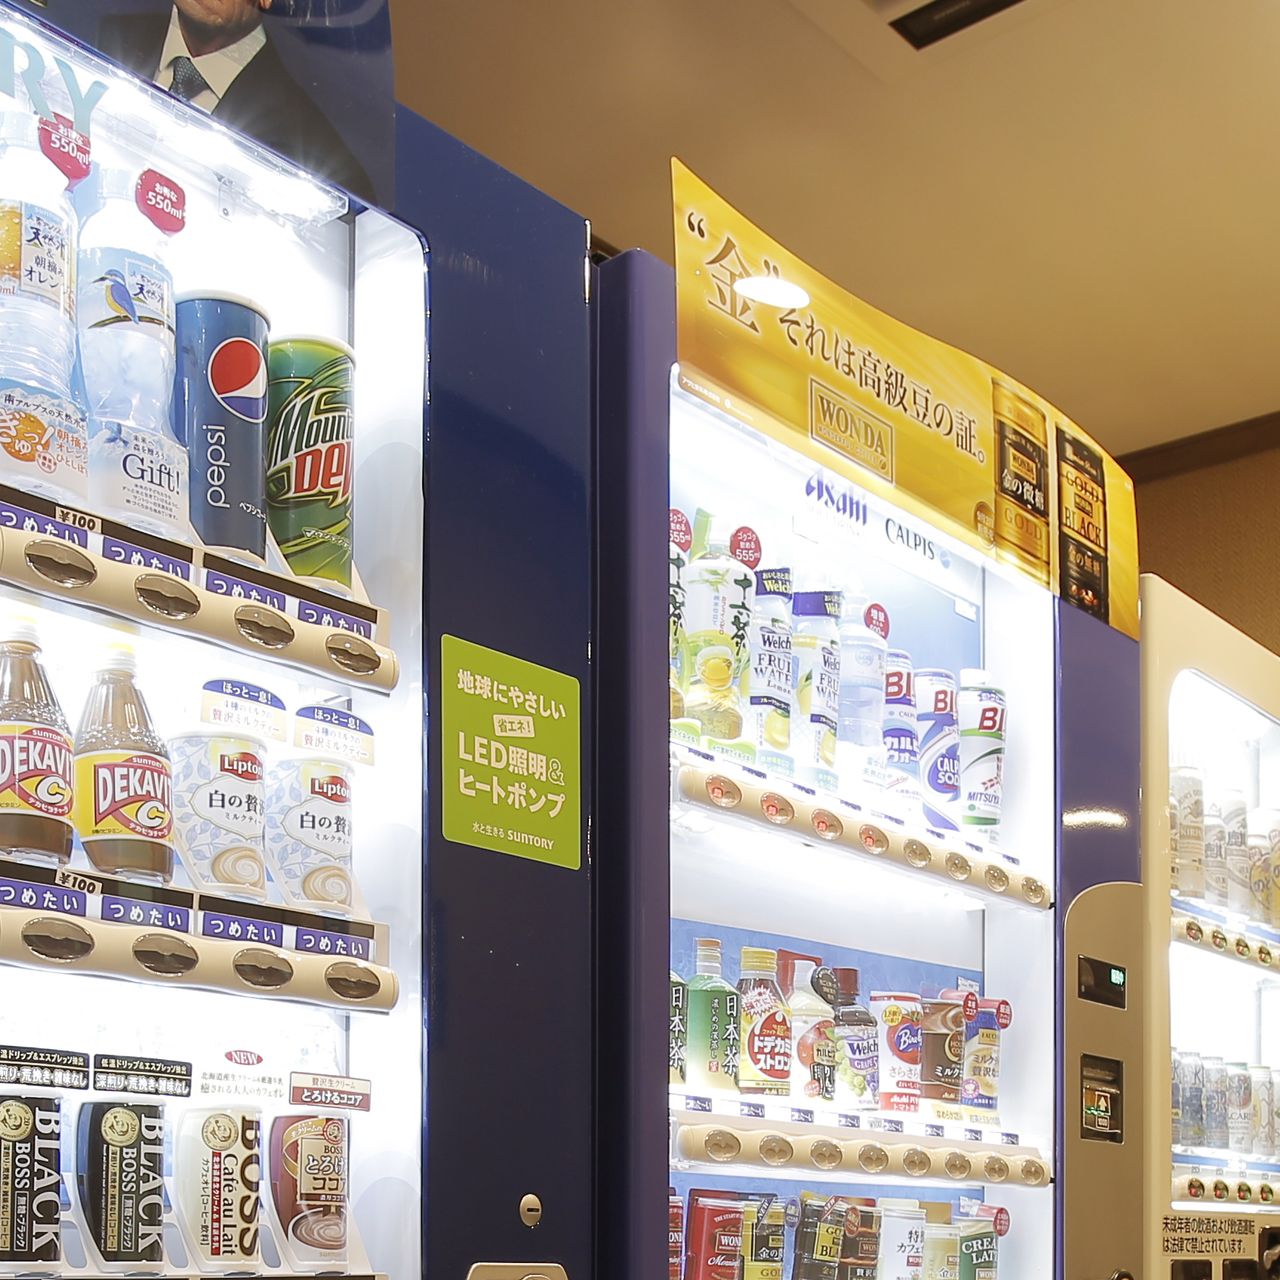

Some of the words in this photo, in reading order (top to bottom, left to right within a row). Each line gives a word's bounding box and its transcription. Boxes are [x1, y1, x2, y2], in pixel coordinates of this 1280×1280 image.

[779, 309, 985, 465] それは高級豆の証。
[818, 394, 887, 457] WONDA
[123, 454, 180, 494] Gift!
[203, 425, 230, 508] pepsi
[1065, 470, 1099, 502] GOLD
[805, 468, 867, 526] Asahi
[1002, 469, 1044, 510] 金の微糖
[885, 517, 935, 561] CALPIS
[1005, 507, 1041, 540] GOLD
[1064, 506, 1101, 547] BLACK
[457, 668, 566, 720] 地球にやさしい
[458, 731, 565, 786] LED照明&
[36, 776, 66, 803] C
[459, 768, 565, 818] ヒートポンプ
[137, 800, 167, 828] C
[473, 821, 504, 838] 水と生きる
[508, 830, 554, 850] SUNTORY
[59, 873, 96, 895] ¥100
[209, 918, 276, 941] つめたい
[301, 933, 364, 957] つめたい
[670, 986, 685, 1068] 日本茶
[723, 995, 739, 1077] 日本茶
[231, 1052, 258, 1064] NEW
[302, 1089, 363, 1106] とろけるココア
[15, 1142, 30, 1189] BOSS
[32, 1106, 60, 1252] BLACK
[122, 1148, 136, 1192] BOSS
[137, 1114, 164, 1252] BLACK
[222, 1153, 238, 1191] Café
[222, 1196, 238, 1217] au
[1162, 1217, 1255, 1235] 未成年者の飲酒および飲酒運転
[222, 1218, 238, 1256] Lait
